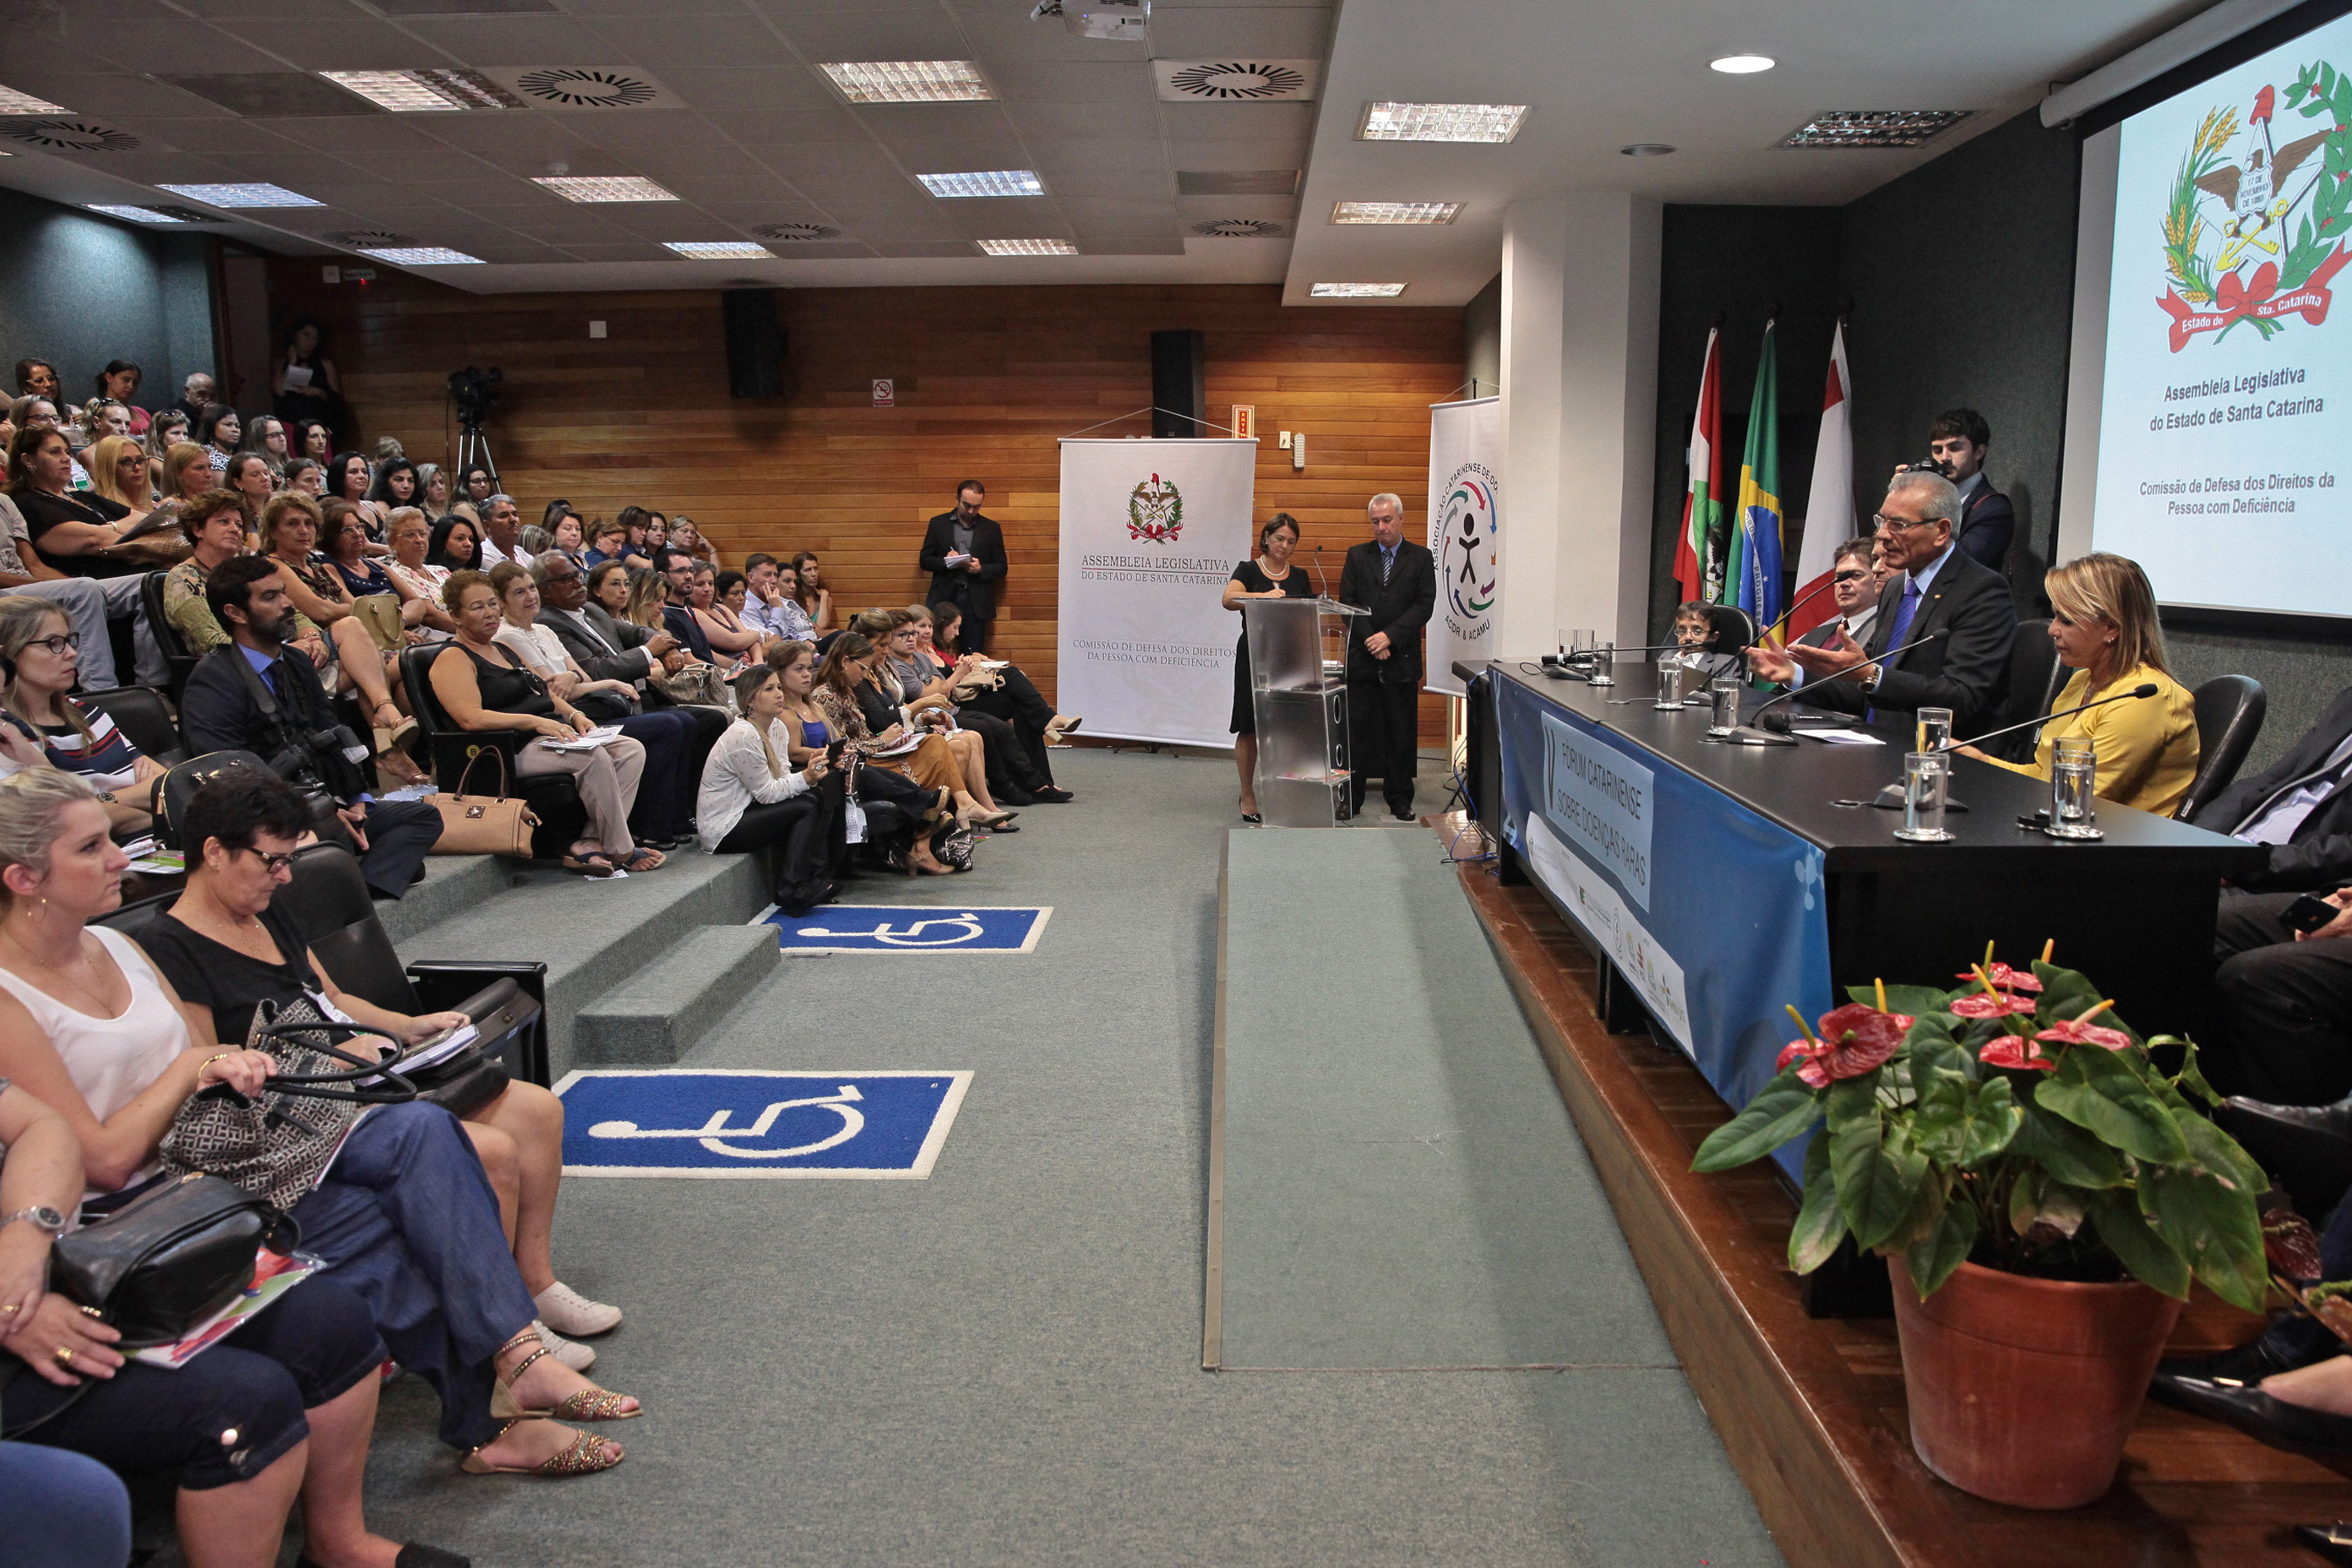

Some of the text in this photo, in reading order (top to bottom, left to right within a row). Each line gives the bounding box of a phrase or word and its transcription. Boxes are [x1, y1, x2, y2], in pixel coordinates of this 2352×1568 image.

[2181, 292, 2322, 333] Estado de Sta. Catarina
[2164, 367, 2306, 402] Assembleia Legislativa
[2149, 396, 2324, 432] do Estado de Santa Catarina
[1445, 462, 1482, 496] CATARINENSE
[1481, 464, 1491, 481] DE
[2139, 471, 2335, 496] Comissão de Defesa dos Direitos da
[2167, 497, 2295, 515] Pessoa com Deficiência
[1081, 554, 1230, 571] ASSEMBLEIA LEGISLATIVA
[1081, 570, 1229, 585] DO ESTADO DE SANTA CATARINA
[1753, 565, 1762, 625] PROGRESS
[1444, 614, 1461, 637] ACDR
[1468, 618, 1490, 640] ACAMU
[1072, 639, 1238, 658] COMISSÃO DE DEFESA DOS DIREITOS
[1087, 651, 1220, 668] DA PESSOA COM DEFICIÊNCIA
[470, 748, 476, 756] B
[1587, 759, 1642, 821] CATARINENSE
[1557, 787, 1581, 828] SOBRE
[1582, 805, 1620, 859] DOENÇAS
[1620, 836, 1647, 886] RARAS
